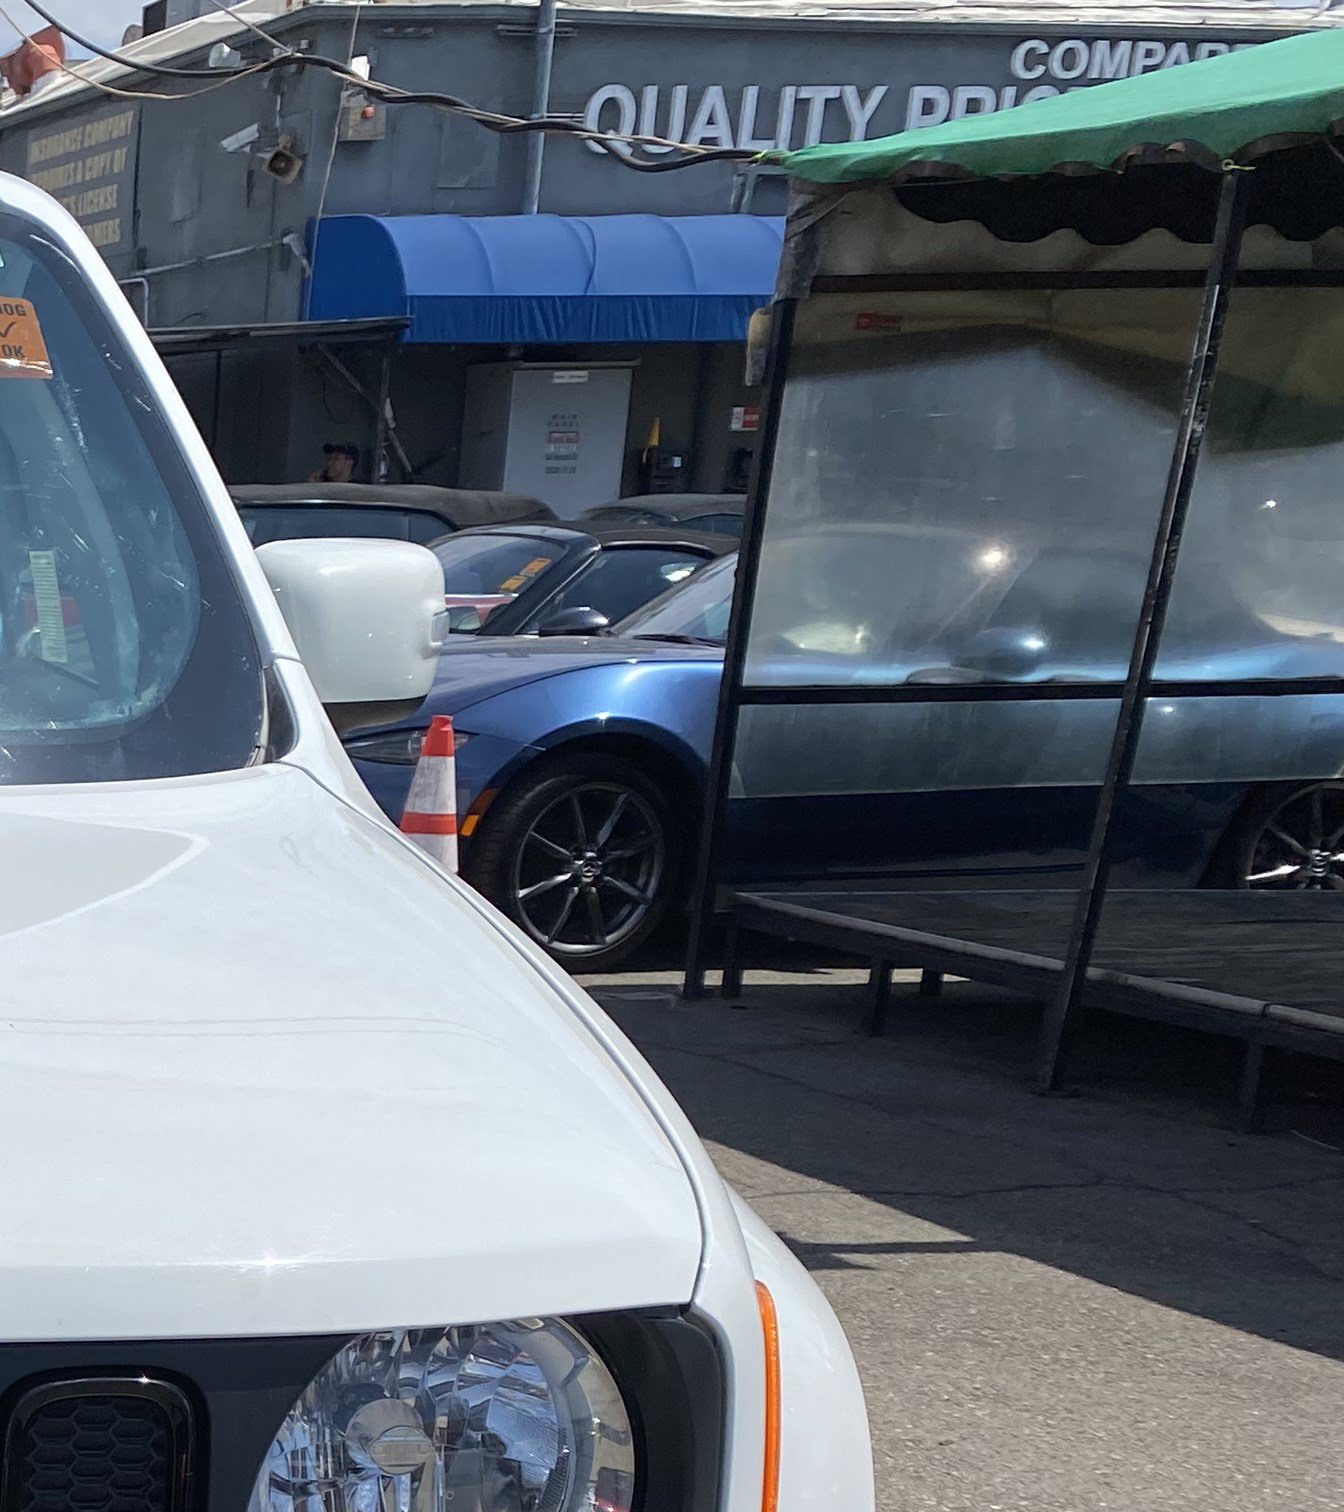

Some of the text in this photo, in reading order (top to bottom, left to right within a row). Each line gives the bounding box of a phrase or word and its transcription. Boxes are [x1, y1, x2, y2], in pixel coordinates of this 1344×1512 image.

[1011, 39, 1262, 79] COMPA
[584, 84, 889, 157] QUALITY
[1, 343, 26, 358] OK
